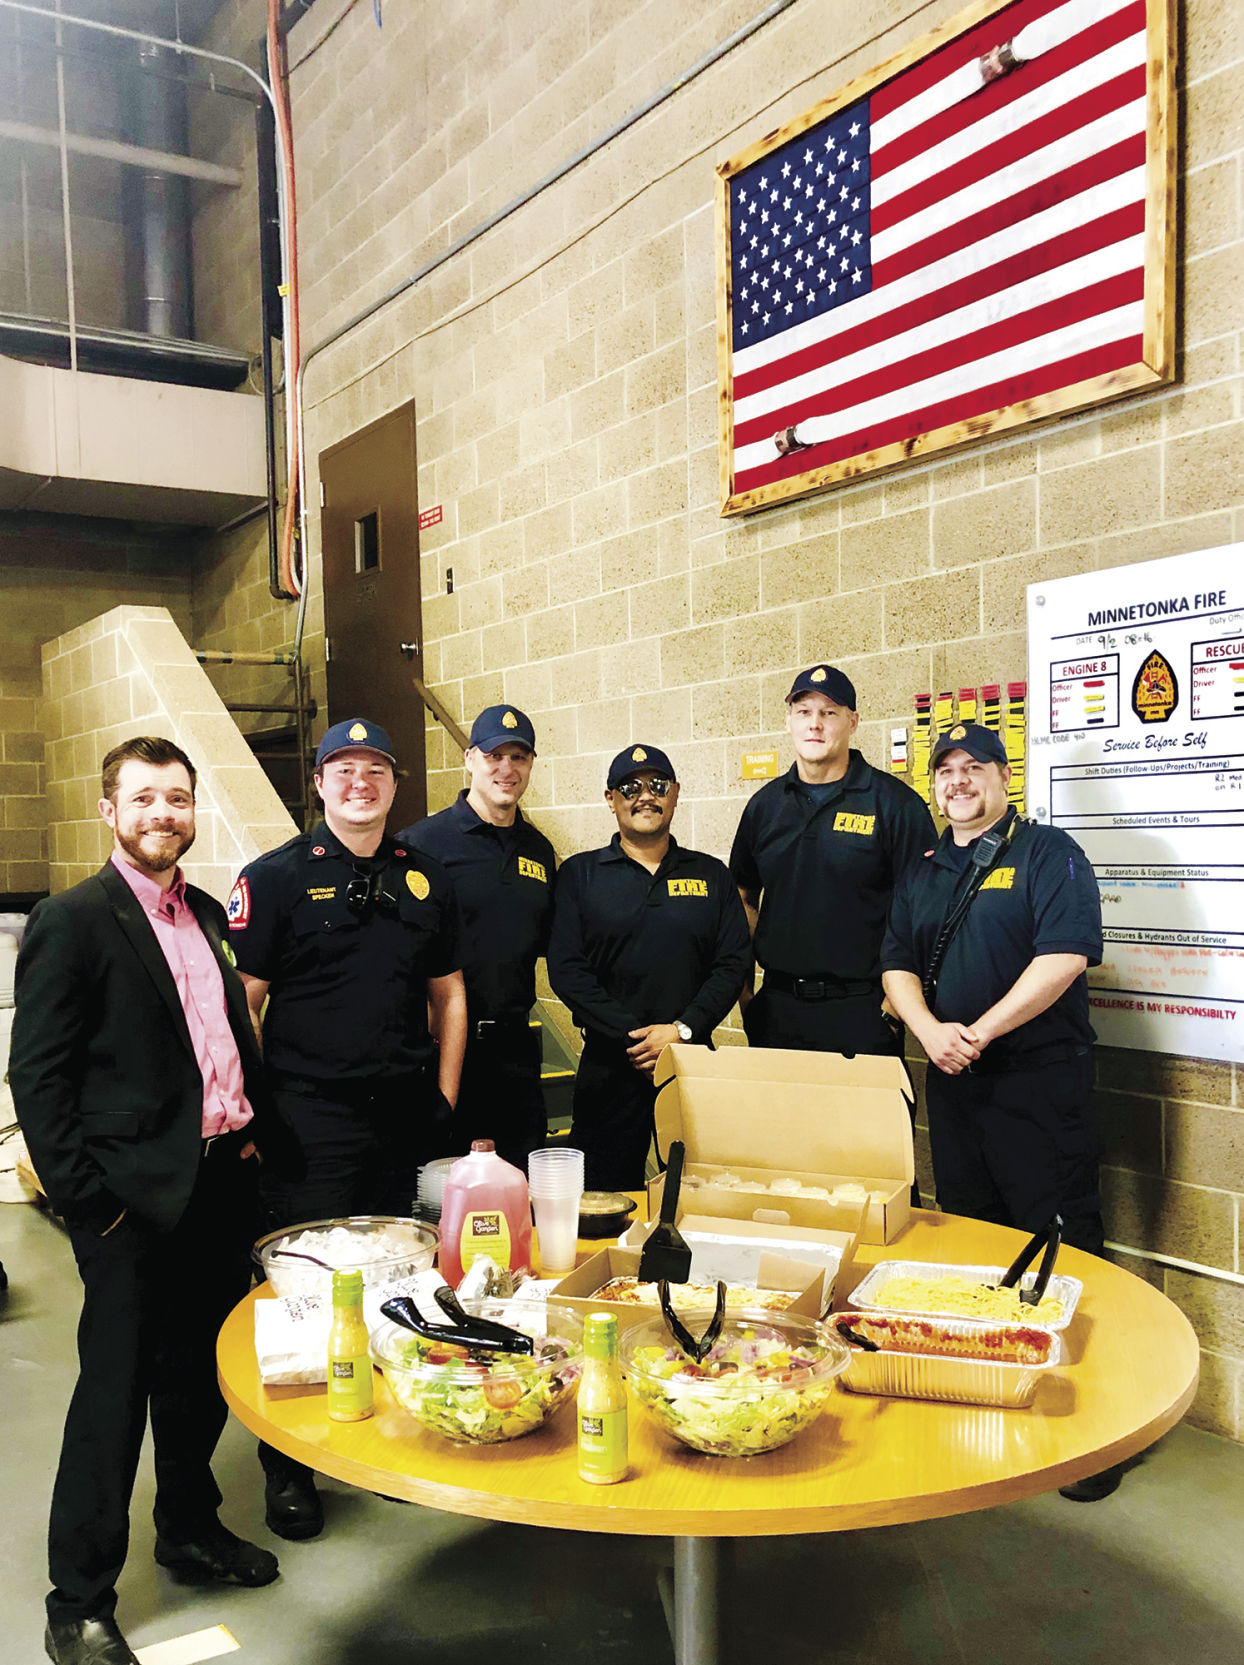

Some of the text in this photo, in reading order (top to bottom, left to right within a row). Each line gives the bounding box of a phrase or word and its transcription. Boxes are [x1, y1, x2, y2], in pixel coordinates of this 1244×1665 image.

[1088, 590, 1227, 627] MINNETONKA FIRE
[1209, 617, 1226, 625] Duty
[1076, 636, 1092, 645] DATE
[1062, 661, 1107, 676] ENGINE 8
[1147, 661, 1164, 671] FIRE
[1193, 667, 1217, 675] Officer
[1052, 684, 1073, 692] Officer
[1193, 680, 1215, 688] Driver
[1052, 696, 1070, 704] Driver
[1103, 731, 1208, 752] Service Before Self
[745, 754, 774, 764] TRAINING
[1085, 767, 1100, 776] Shift
[1101, 766, 1122, 775] Duties
[1112, 817, 1147, 825] Scheduled
[1149, 816, 1171, 824] Events
[1180, 815, 1200, 823] Tours
[1105, 868, 1139, 877] Apparatus
[1148, 868, 1185, 877] Equipment
[1186, 868, 1209, 876] Status
[1108, 930, 1136, 939] Closures
[1138, 931, 1143, 939] &
[1145, 933, 1175, 942] Hydrants
[1177, 934, 1190, 942] Out
[1192, 934, 1199, 943] of
[1201, 935, 1227, 944] Service
[1136, 1001, 1144, 1010] IS
[1147, 1002, 1162, 1013] MY
[1164, 1003, 1236, 1021] RESPONSIBILTY
